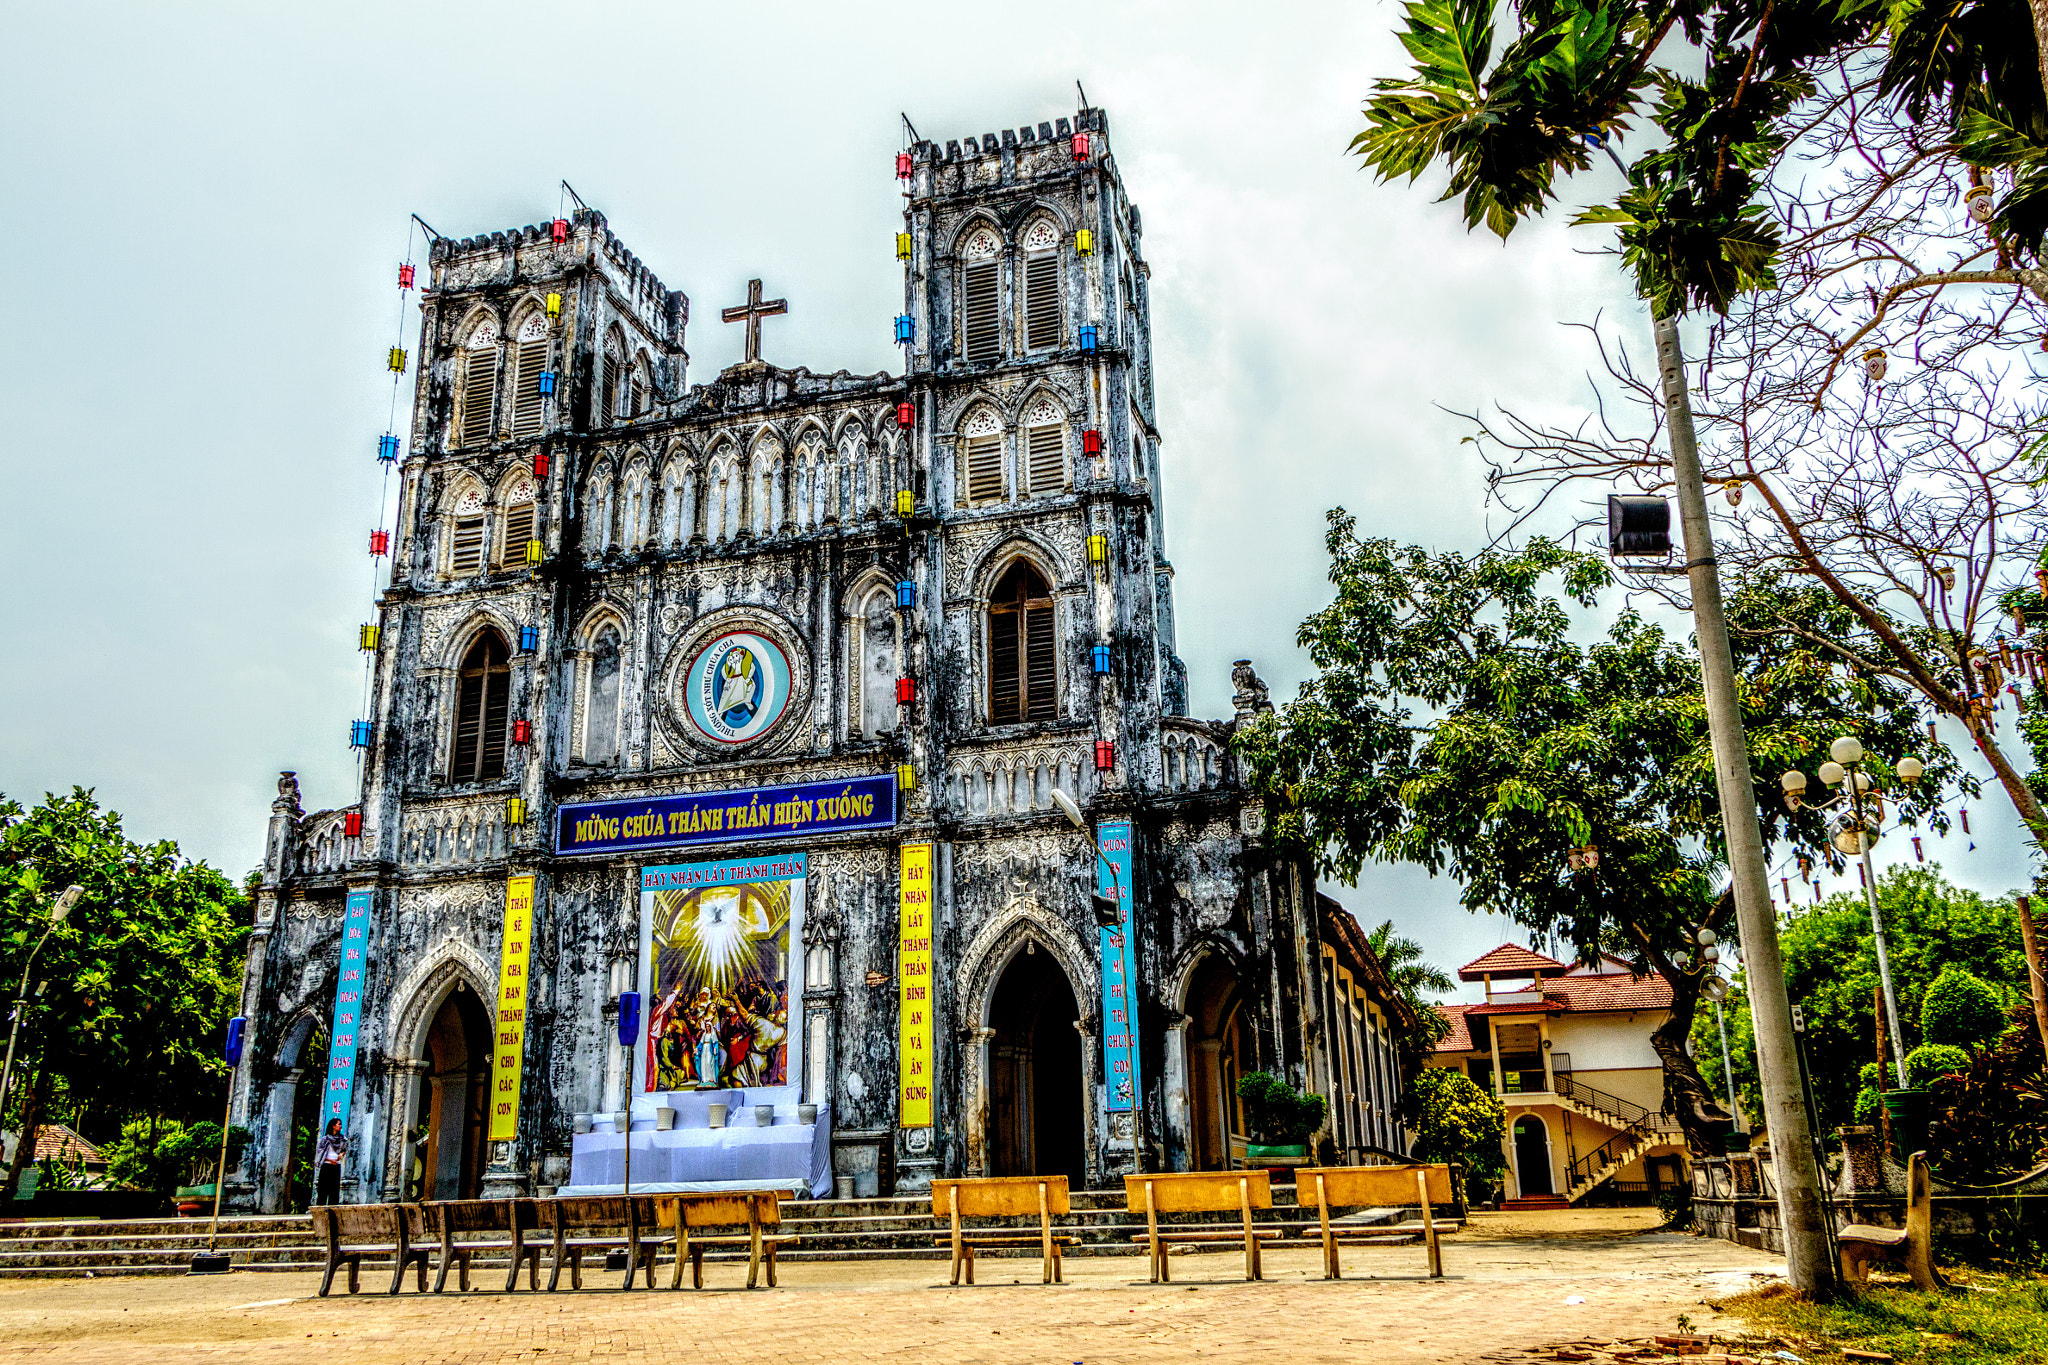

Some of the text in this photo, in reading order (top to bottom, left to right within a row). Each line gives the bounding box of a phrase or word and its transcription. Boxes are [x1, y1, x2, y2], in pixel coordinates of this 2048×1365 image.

[703, 639, 735, 737] THƯƠNG XÓT NHƯ CHÚA CHA
[575, 785, 874, 842] MỪNG CHÚA THÁNH THẦN HIỆN XUỐNG
[1103, 836, 1127, 852] MUÔN
[644, 855, 803, 887] HÃY NHẬN LẤY THÁNH THẦN
[908, 864, 924, 880] HÃY
[905, 887, 927, 906] NHẬN
[514, 916, 522, 932] SẼ
[908, 908, 924, 928] LẤY
[509, 941, 523, 954] XIN
[904, 935, 929, 952] THÁNH
[347, 949, 359, 960] HOA
[507, 964, 521, 976] CHA
[505, 986, 520, 999] BAN
[906, 984, 926, 1000] BÌNH
[340, 1013, 353, 1024] CON
[500, 1006, 523, 1022] THÁNH
[910, 1012, 922, 1025] AN
[910, 1033, 922, 1049] VÀ
[500, 1056, 515, 1068] CHO
[910, 1057, 922, 1075] ÂN
[499, 1075, 513, 1092] CÁC
[497, 1102, 511, 1115] CON
